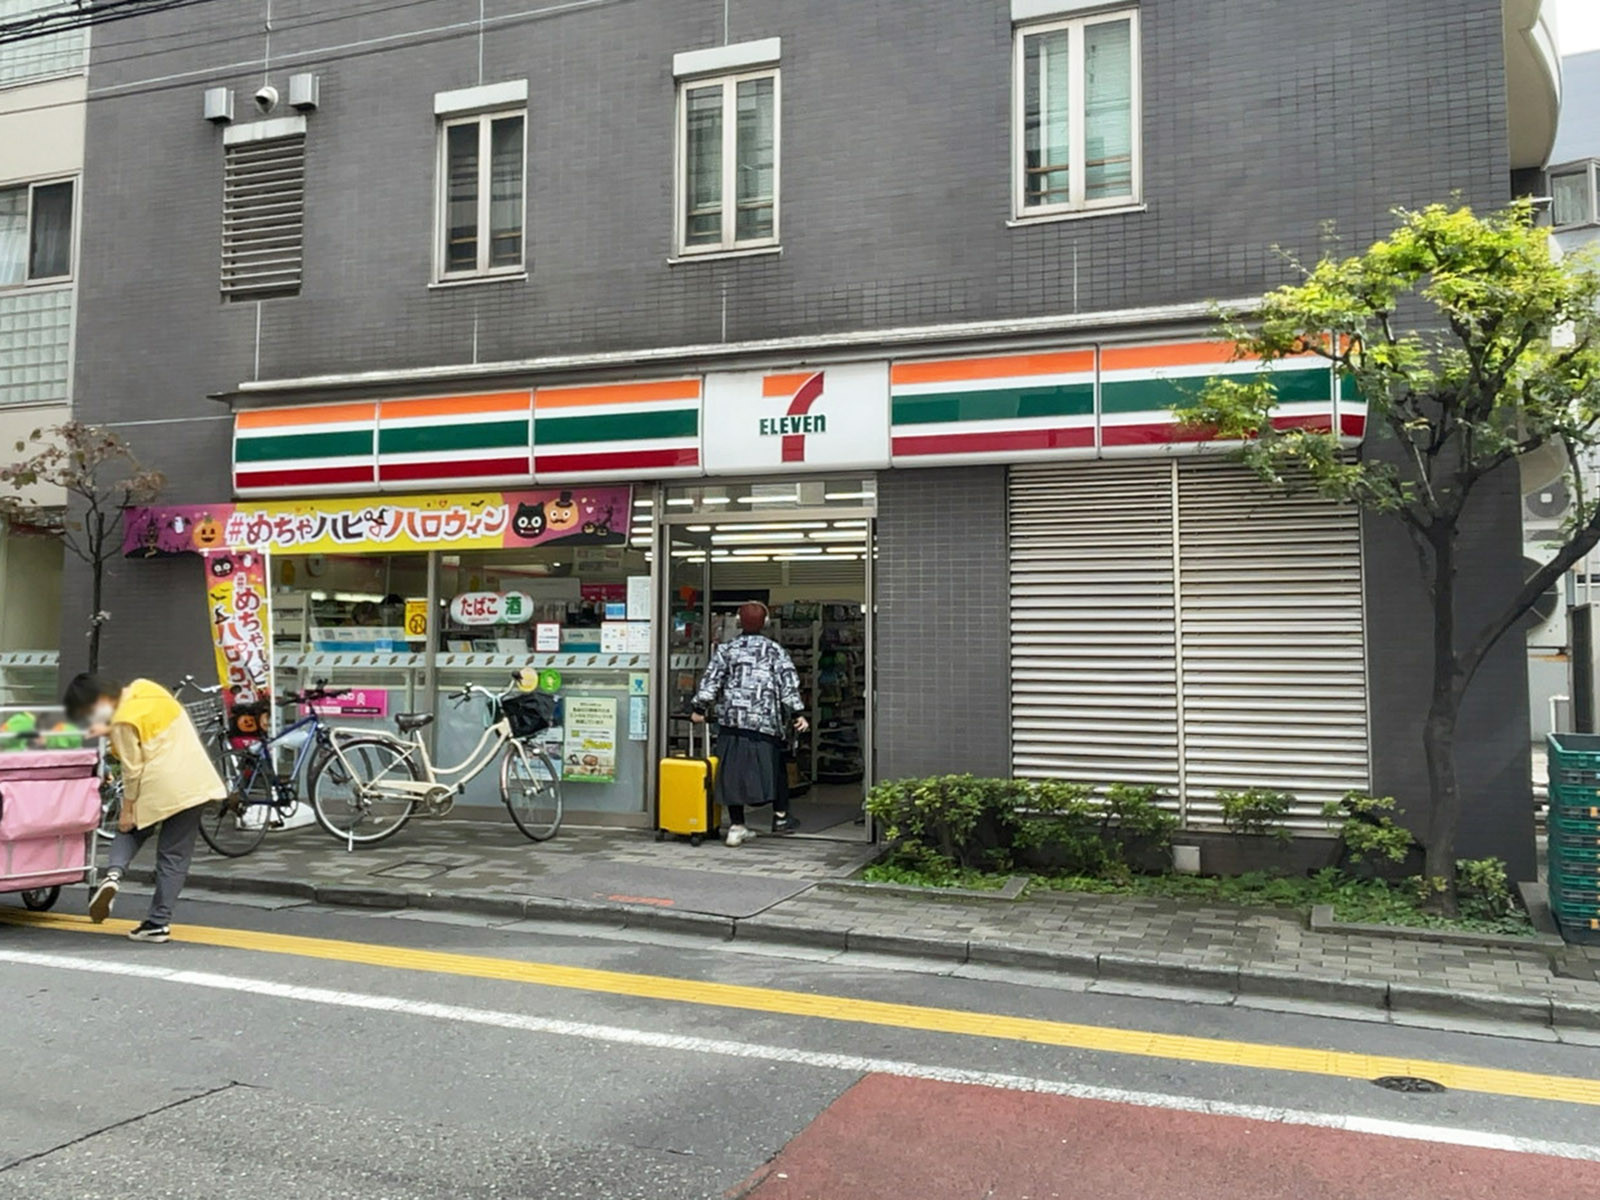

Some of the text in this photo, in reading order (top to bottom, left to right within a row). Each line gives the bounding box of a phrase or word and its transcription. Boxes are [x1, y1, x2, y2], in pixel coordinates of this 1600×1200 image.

[762, 371, 825, 463] 7
[460, 596, 522, 616] たばこ 酒
